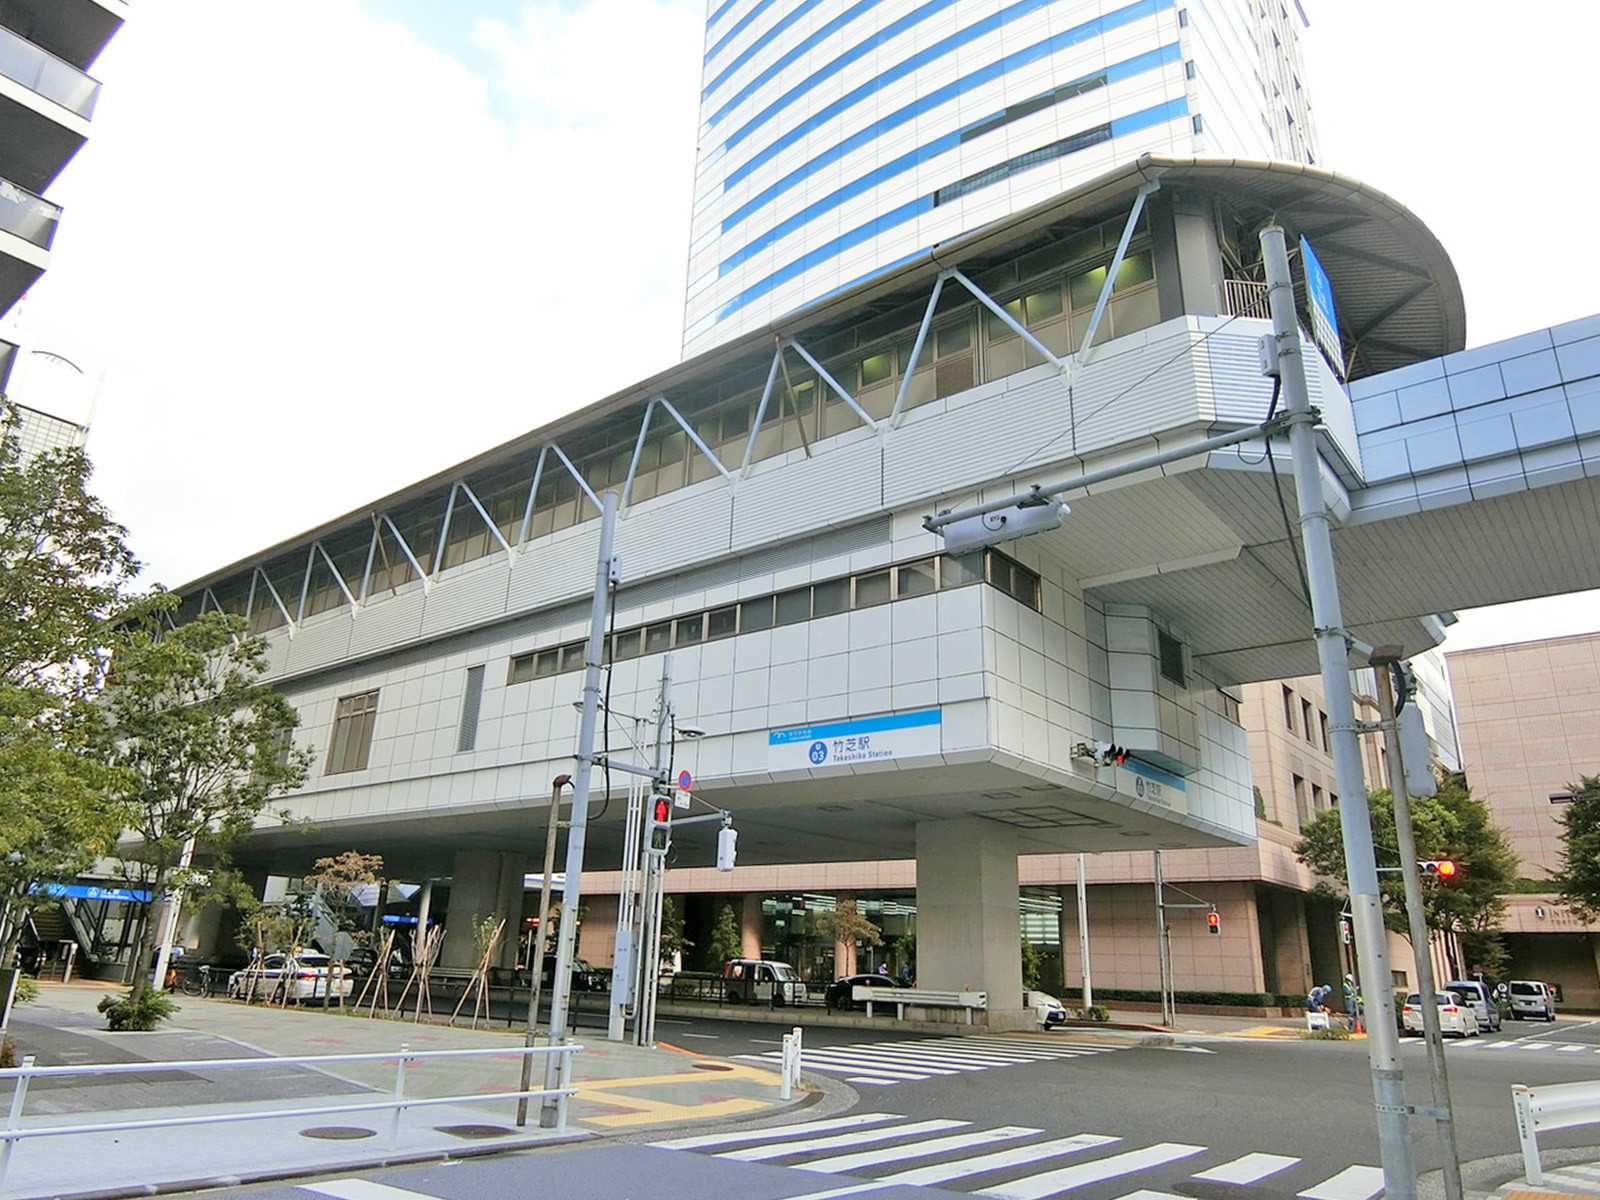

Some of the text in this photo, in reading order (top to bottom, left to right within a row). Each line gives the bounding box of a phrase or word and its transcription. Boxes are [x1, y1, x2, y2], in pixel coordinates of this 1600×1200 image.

[815, 743, 822, 751] U
[833, 736, 870, 754] 竹芝駅
[811, 751, 825, 762] 03
[833, 749, 893, 762] Takeshiba Station
